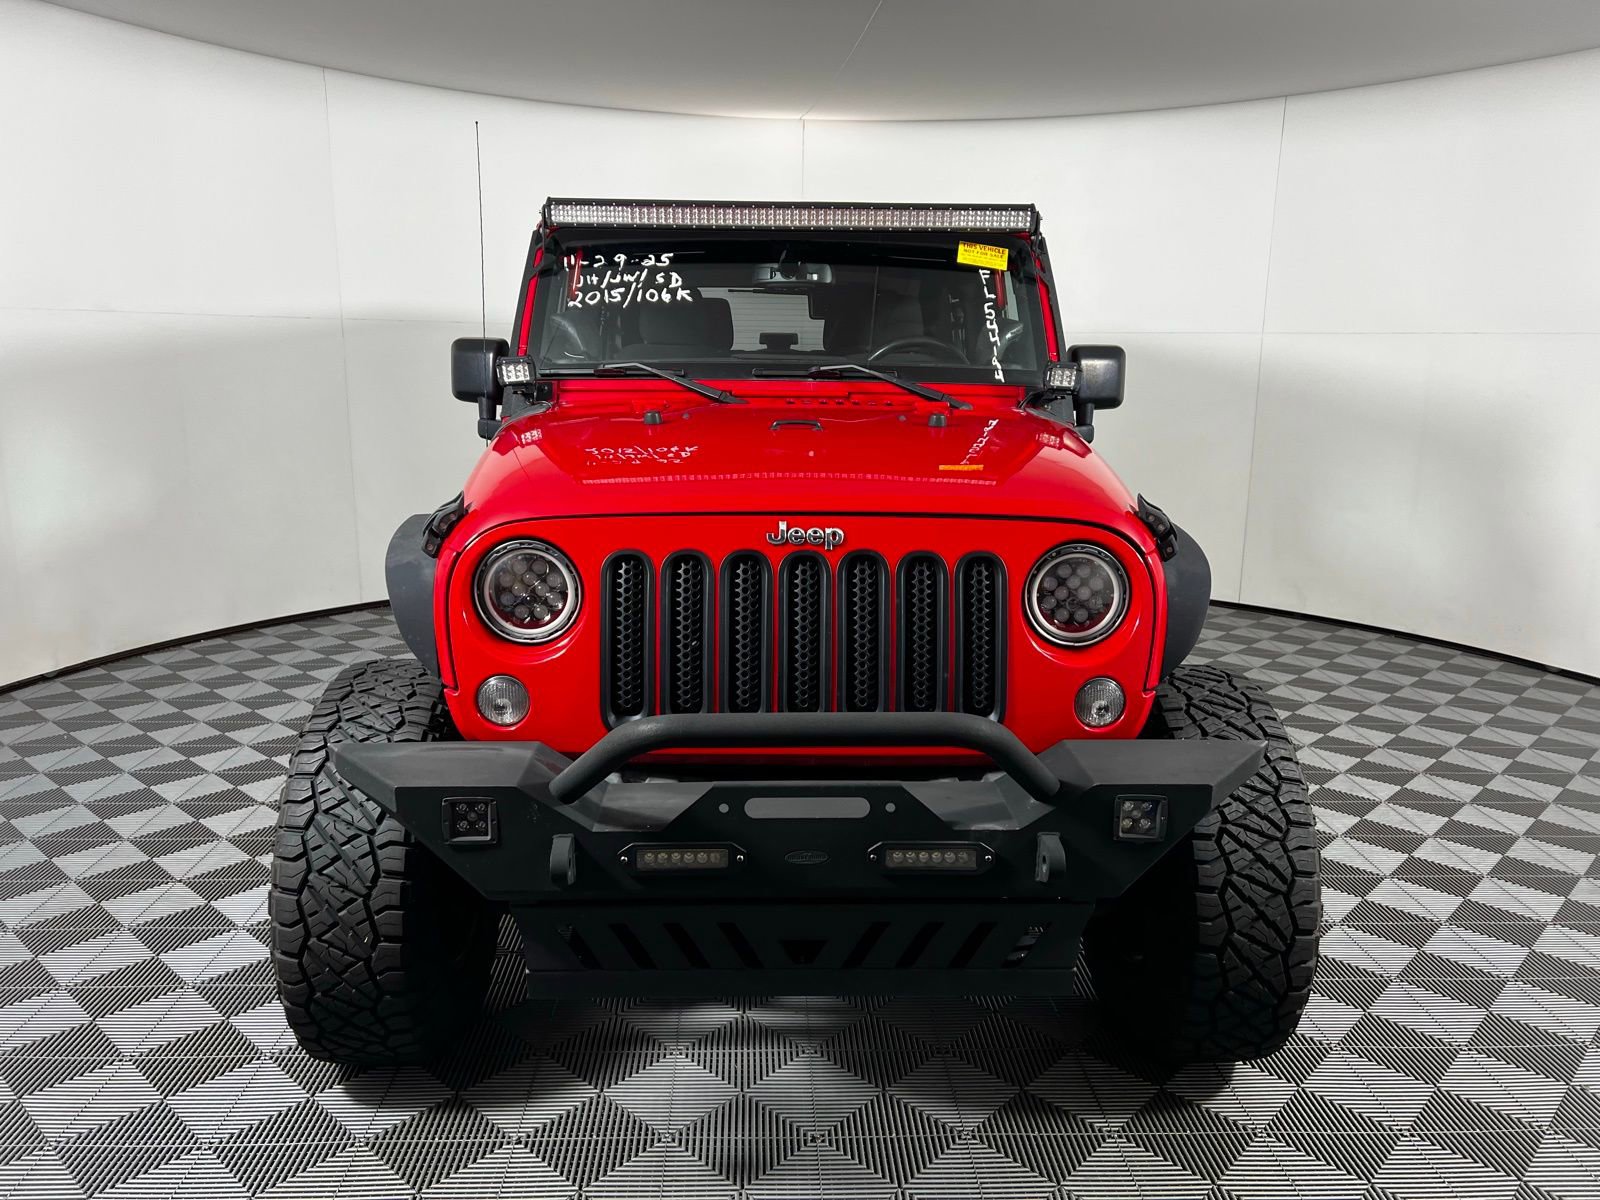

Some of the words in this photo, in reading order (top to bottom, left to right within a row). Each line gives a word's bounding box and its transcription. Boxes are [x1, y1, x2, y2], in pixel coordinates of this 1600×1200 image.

[963, 242, 978, 250] THIS
[979, 244, 1006, 255] VEHICLE
[766, 520, 844, 551] Jeep
